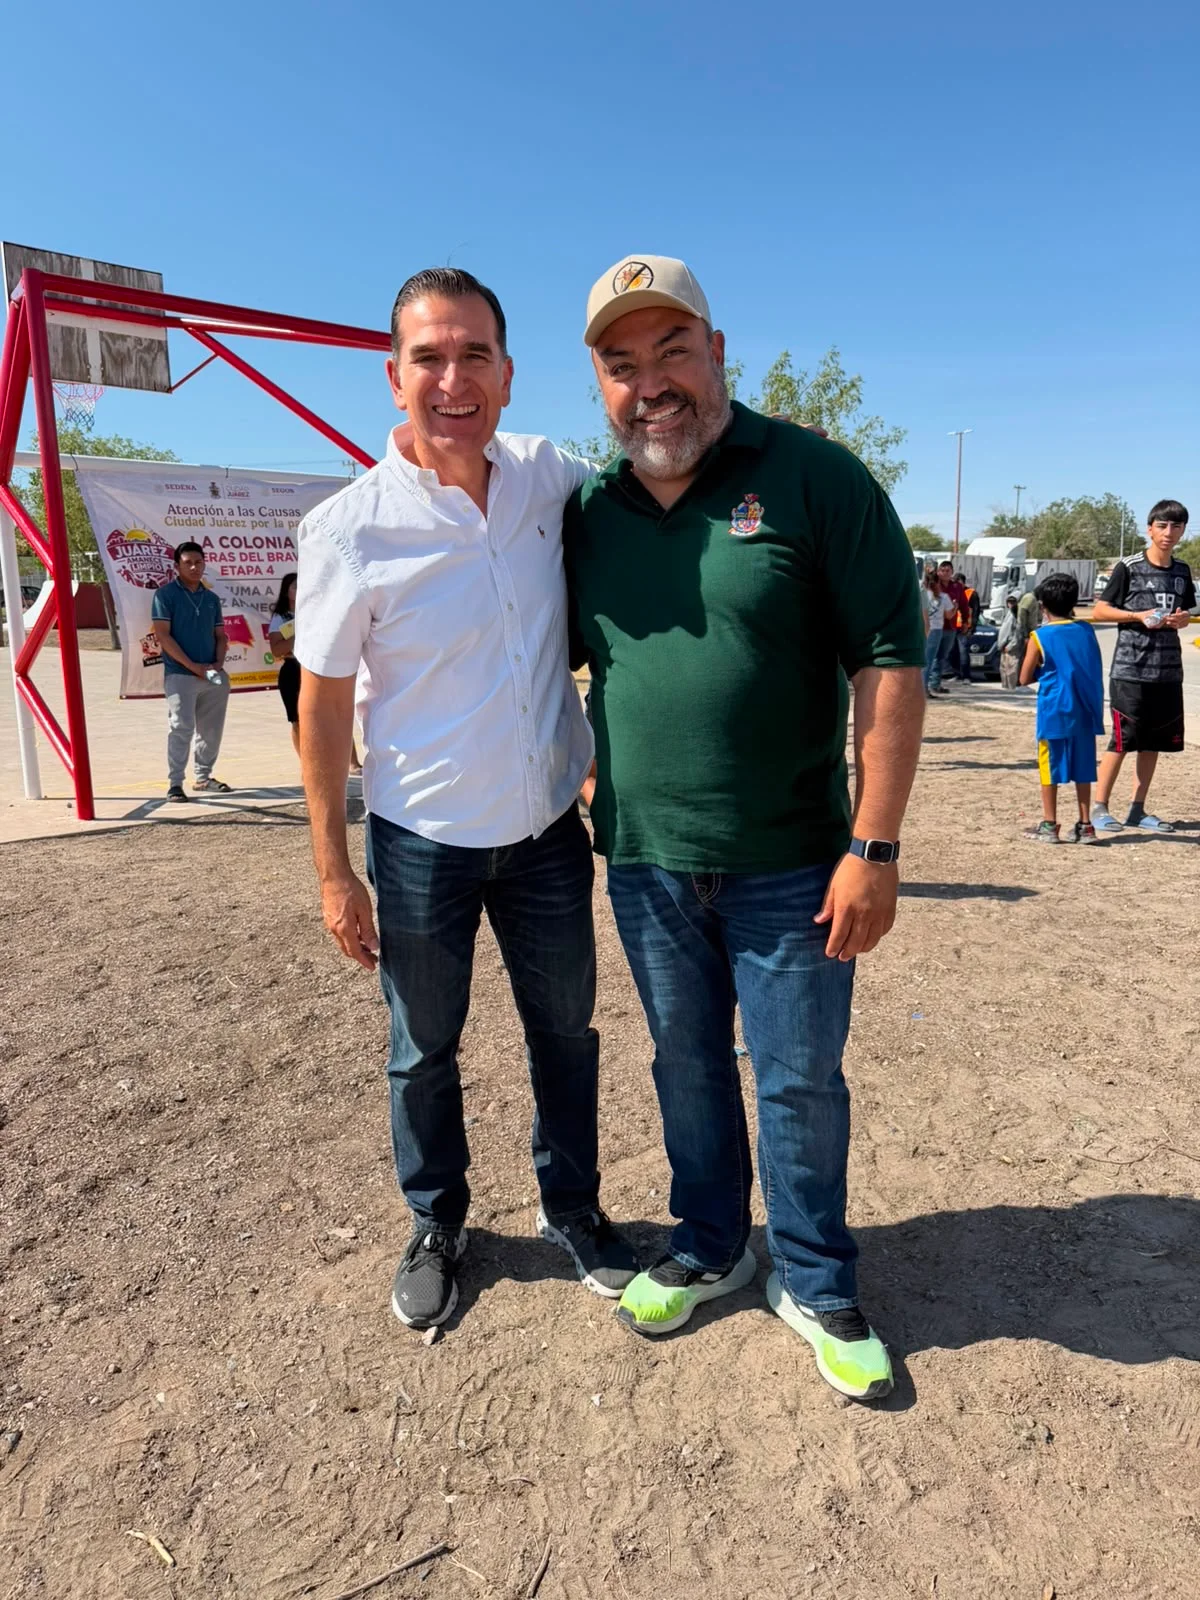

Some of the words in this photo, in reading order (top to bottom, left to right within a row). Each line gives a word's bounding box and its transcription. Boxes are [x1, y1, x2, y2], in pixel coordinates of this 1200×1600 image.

[167, 504, 224, 516] Atención
[228, 507, 234, 516] a
[237, 506, 255, 517] las
[258, 506, 301, 518] Causas
[164, 516, 205, 527] Ciudad
[209, 517, 247, 528] Juárez
[250, 519, 269, 530] por
[274, 518, 284, 528] la
[287, 519, 298, 530] pa
[218, 536, 295, 549] COLONIA
[203, 552, 236, 562] ERAS
[238, 552, 264, 562] DEL
[267, 552, 298, 562] BRAV
[132, 563, 162, 571] LIMPIO
[220, 565, 263, 576] ETAPA
[265, 565, 275, 575] 4
[265, 586, 274, 596] A
[1155, 593, 1175, 609] 99
